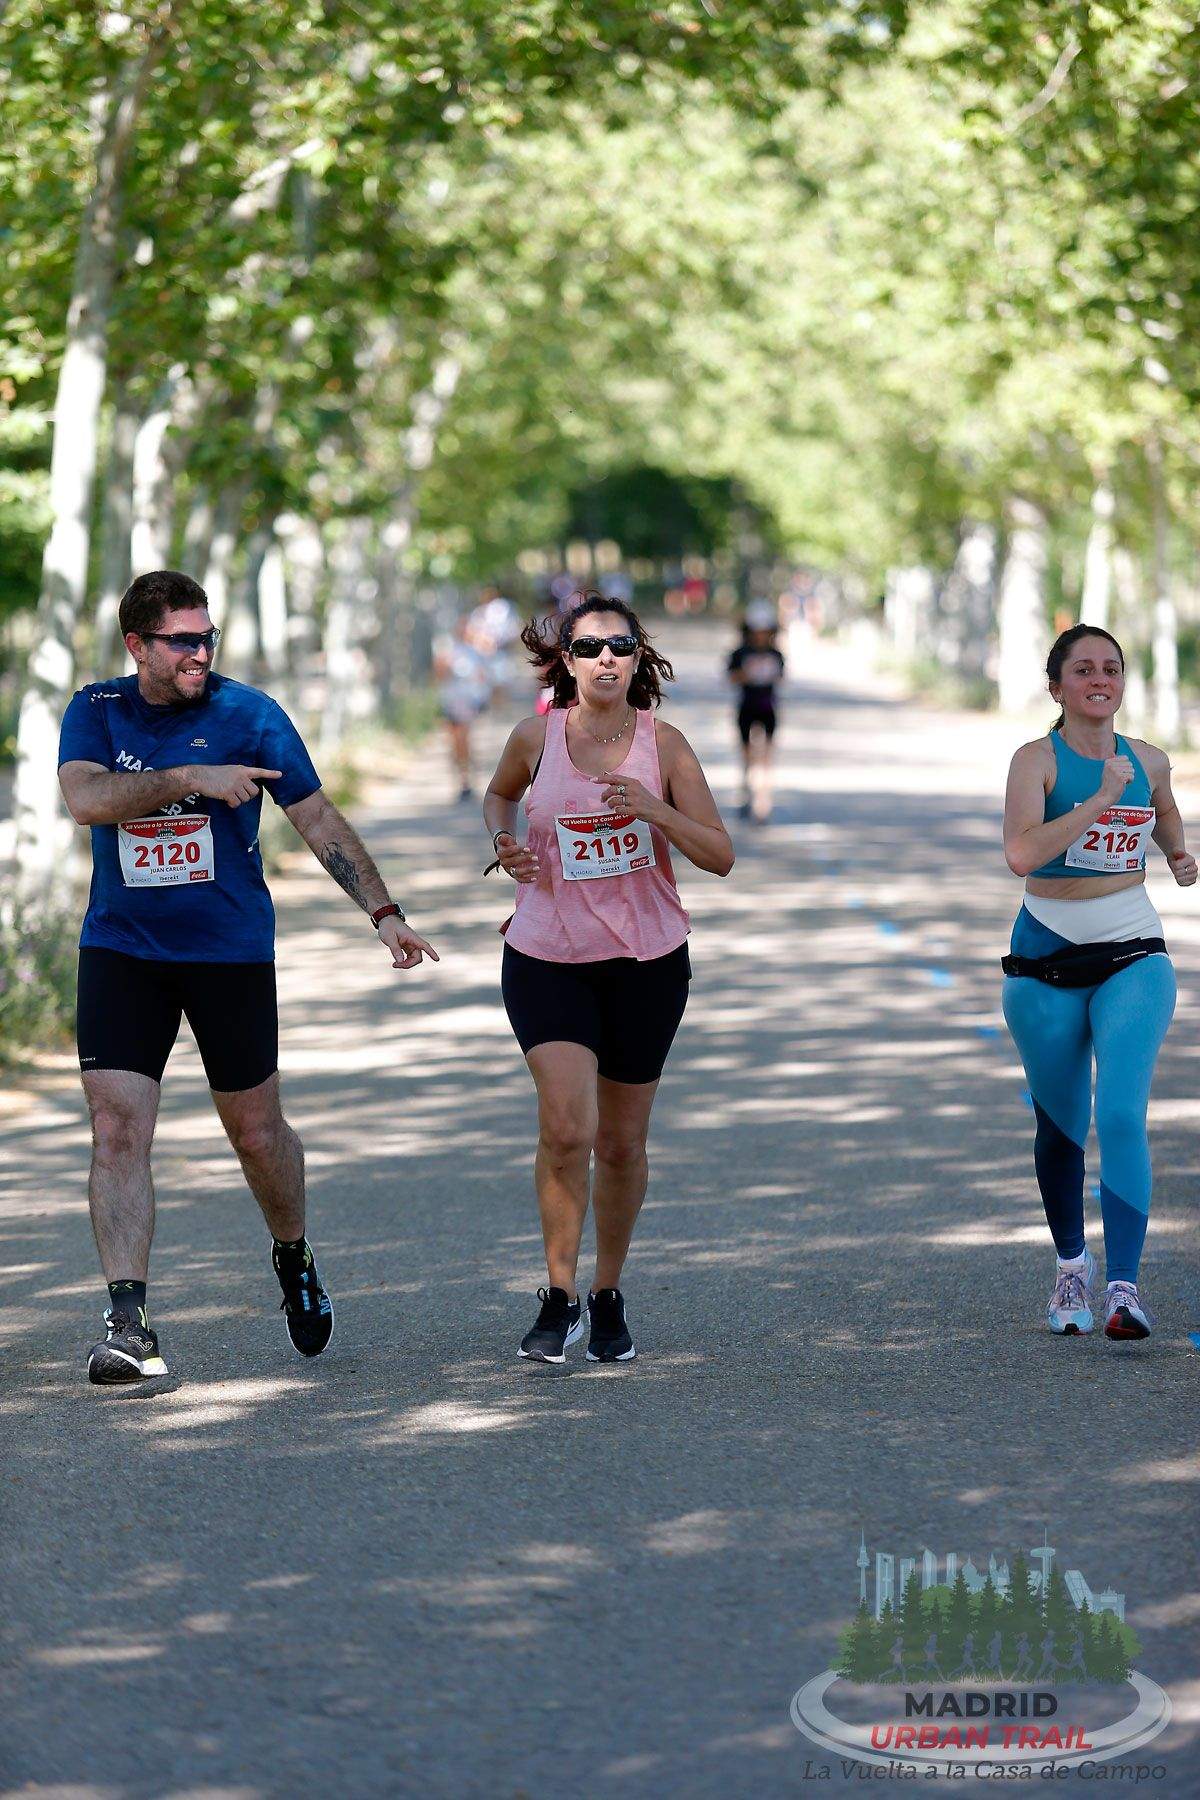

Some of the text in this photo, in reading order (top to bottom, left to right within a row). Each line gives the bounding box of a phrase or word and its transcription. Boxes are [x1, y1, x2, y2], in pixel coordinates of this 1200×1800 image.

[573, 832, 639, 860] 2119
[1083, 831, 1141, 852] 2126
[133, 842, 200, 867] 2120
